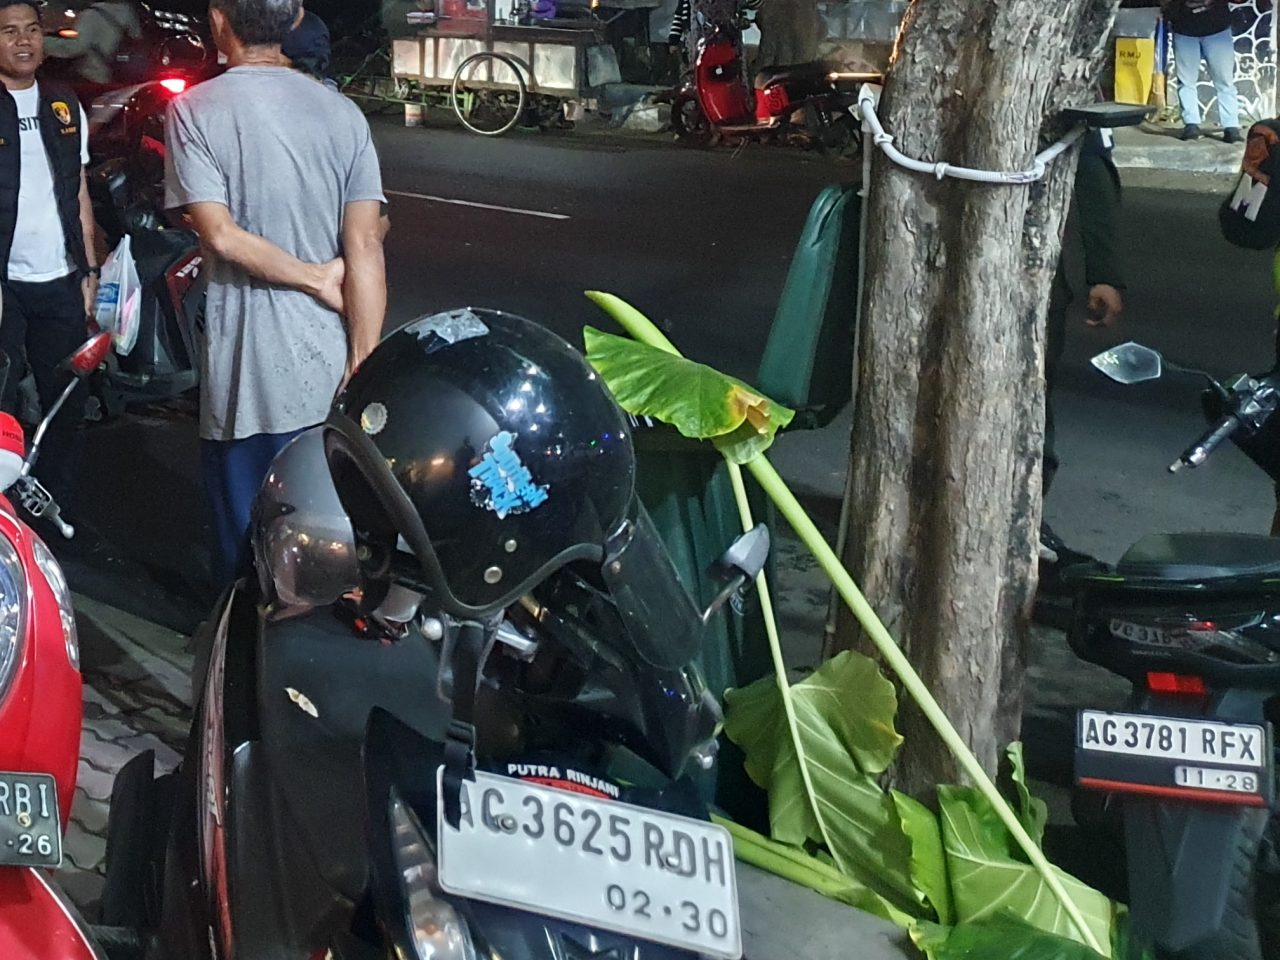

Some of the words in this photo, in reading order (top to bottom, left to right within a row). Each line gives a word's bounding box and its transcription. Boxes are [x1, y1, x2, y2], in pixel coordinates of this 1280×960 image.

[1086, 718, 1118, 747] AG
[1123, 721, 1188, 754] 3781
[1201, 728, 1256, 761] RFX
[507, 762, 561, 779] PUTRA
[566, 768, 621, 799] RINJANI
[521, 794, 632, 863] 3625
[642, 821, 727, 888] RDH
